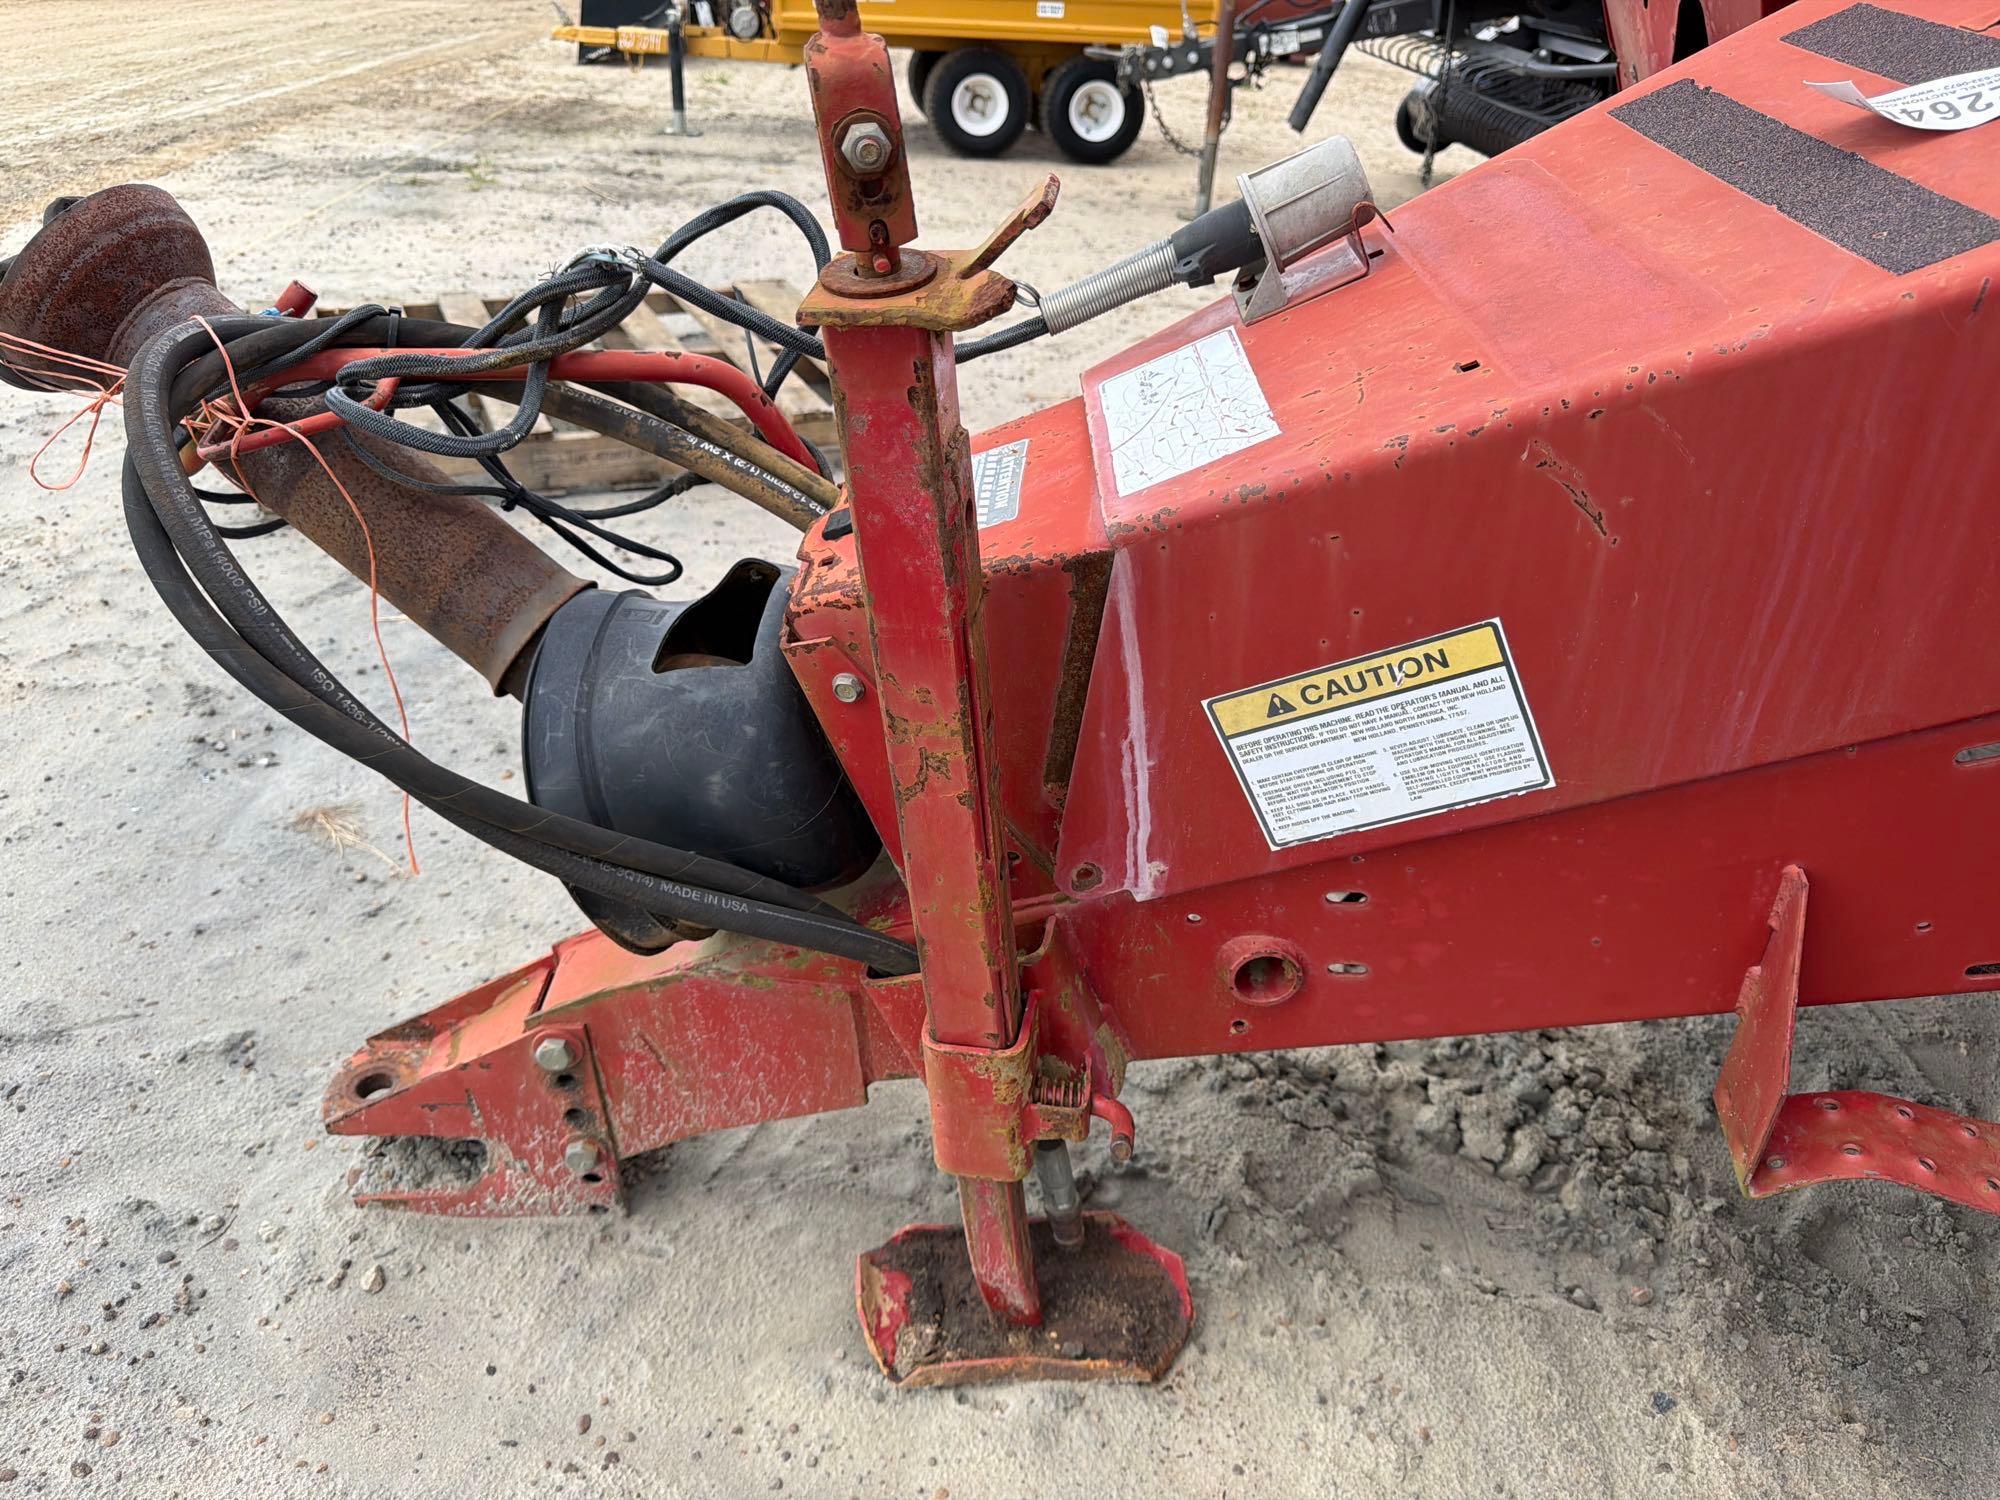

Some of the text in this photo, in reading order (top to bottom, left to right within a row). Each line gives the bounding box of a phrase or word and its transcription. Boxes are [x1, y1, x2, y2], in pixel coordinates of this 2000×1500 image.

[1901, 89, 1957, 106] AUCTION
[605, 400, 643, 421] MADE
[732, 455, 761, 477] (1/2)
[995, 457, 1014, 508] ATTENTION
[189, 513, 216, 550] MPa
[211, 548, 243, 589] (4000
[239, 585, 268, 618] PSI)
[308, 666, 336, 694] ISO
[1300, 648, 1450, 704] CAUTION
[1236, 739, 1262, 751] BEFORE
[1263, 729, 1302, 744] OPERATING
[1302, 724, 1319, 733] THIS
[1355, 709, 1375, 720] READ
[1375, 705, 1390, 714] THE
[1390, 693, 1437, 710] OPERATOR'S
[1438, 684, 1471, 698] MANUAL
[1472, 679, 1489, 689] AND
[1490, 675, 1505, 684] ALL
[1239, 746, 1264, 757] SAFETY
[1326, 727, 1338, 735] YOU
[1348, 721, 1360, 729] NOT
[1361, 716, 1378, 726] HAVE
[1412, 700, 1441, 712] CONTACT
[1442, 695, 1459, 705] YOUR
[1460, 691, 1475, 700] NEW
[1476, 683, 1506, 696] HOLLAND
[1242, 755, 1263, 764] DEALER
[1284, 743, 1309, 753] SERVICE
[1350, 728, 1364, 736] NEW
[1365, 721, 1393, 732] HOLLAND
[1394, 715, 1415, 725] NORTH
[1353, 735, 1367, 743] NEW
[658, 880, 750, 914] MADE IN USA
